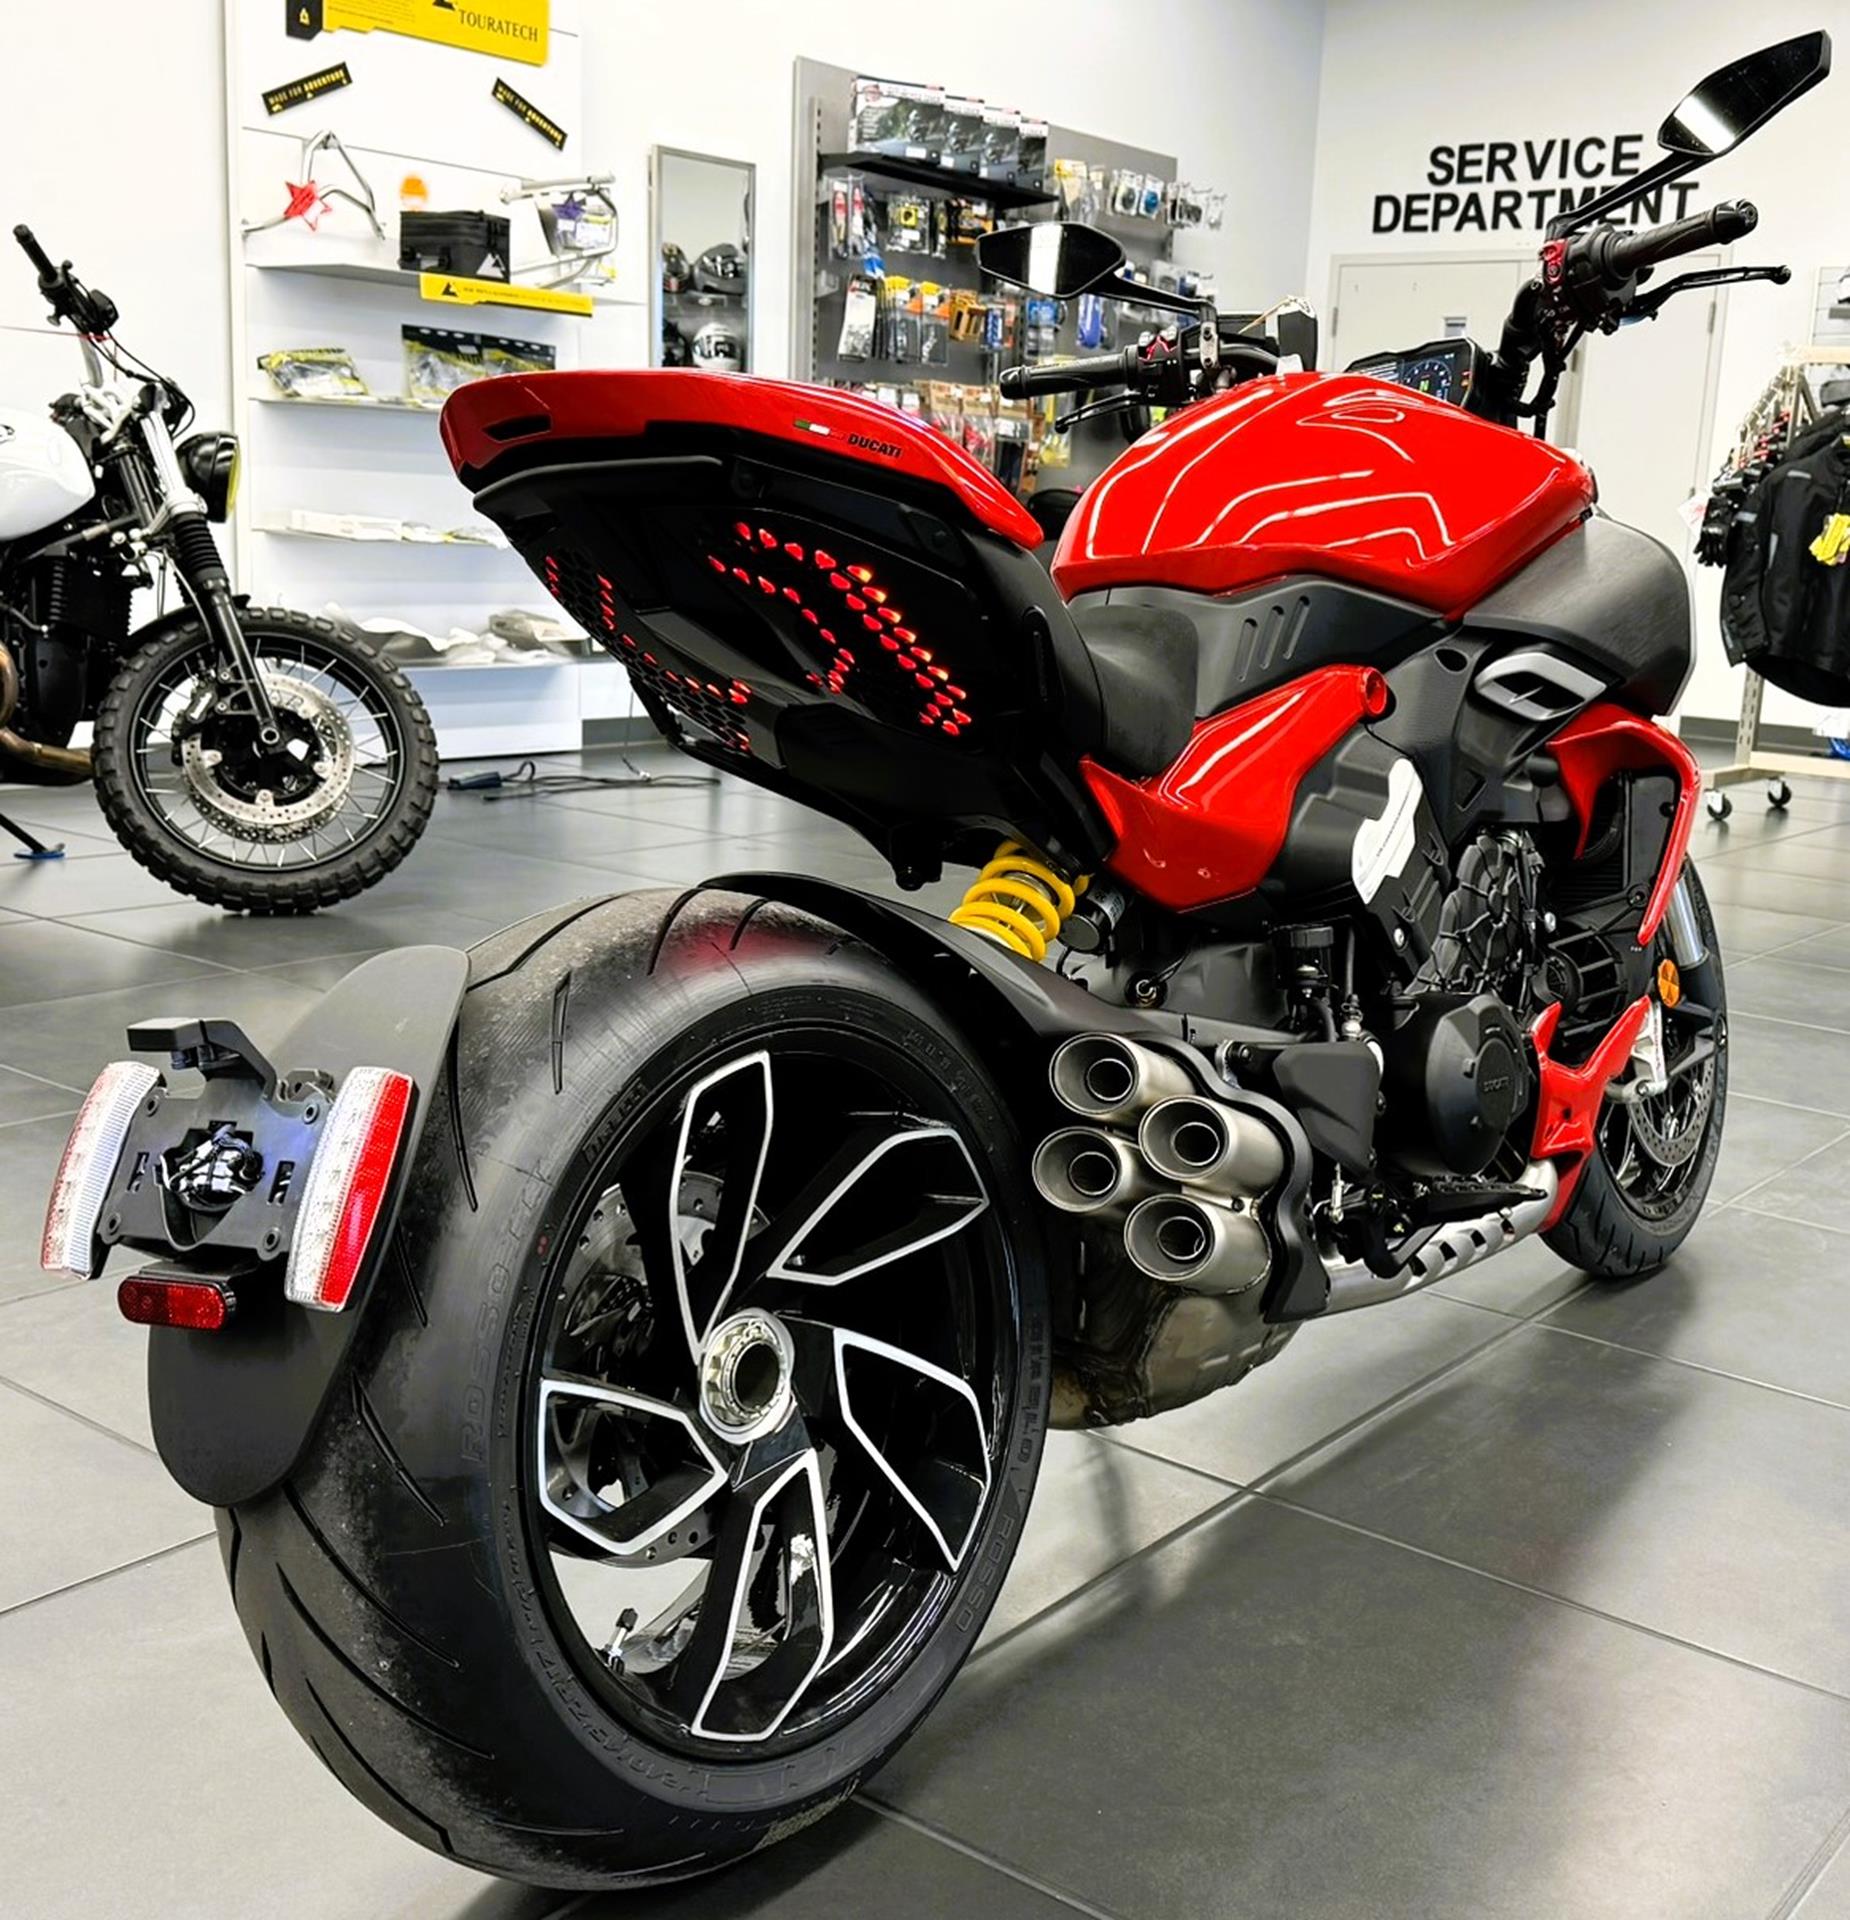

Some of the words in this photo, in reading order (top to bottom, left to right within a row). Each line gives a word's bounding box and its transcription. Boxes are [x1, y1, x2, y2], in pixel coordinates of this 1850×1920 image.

[458, 8, 539, 42] TOURATECH
[1427, 134, 1643, 186] SERVICE
[847, 433, 902, 458] DUCATI
[460, 1263, 512, 1462] ROSSO
[954, 1514, 1016, 1632] ROSSO
